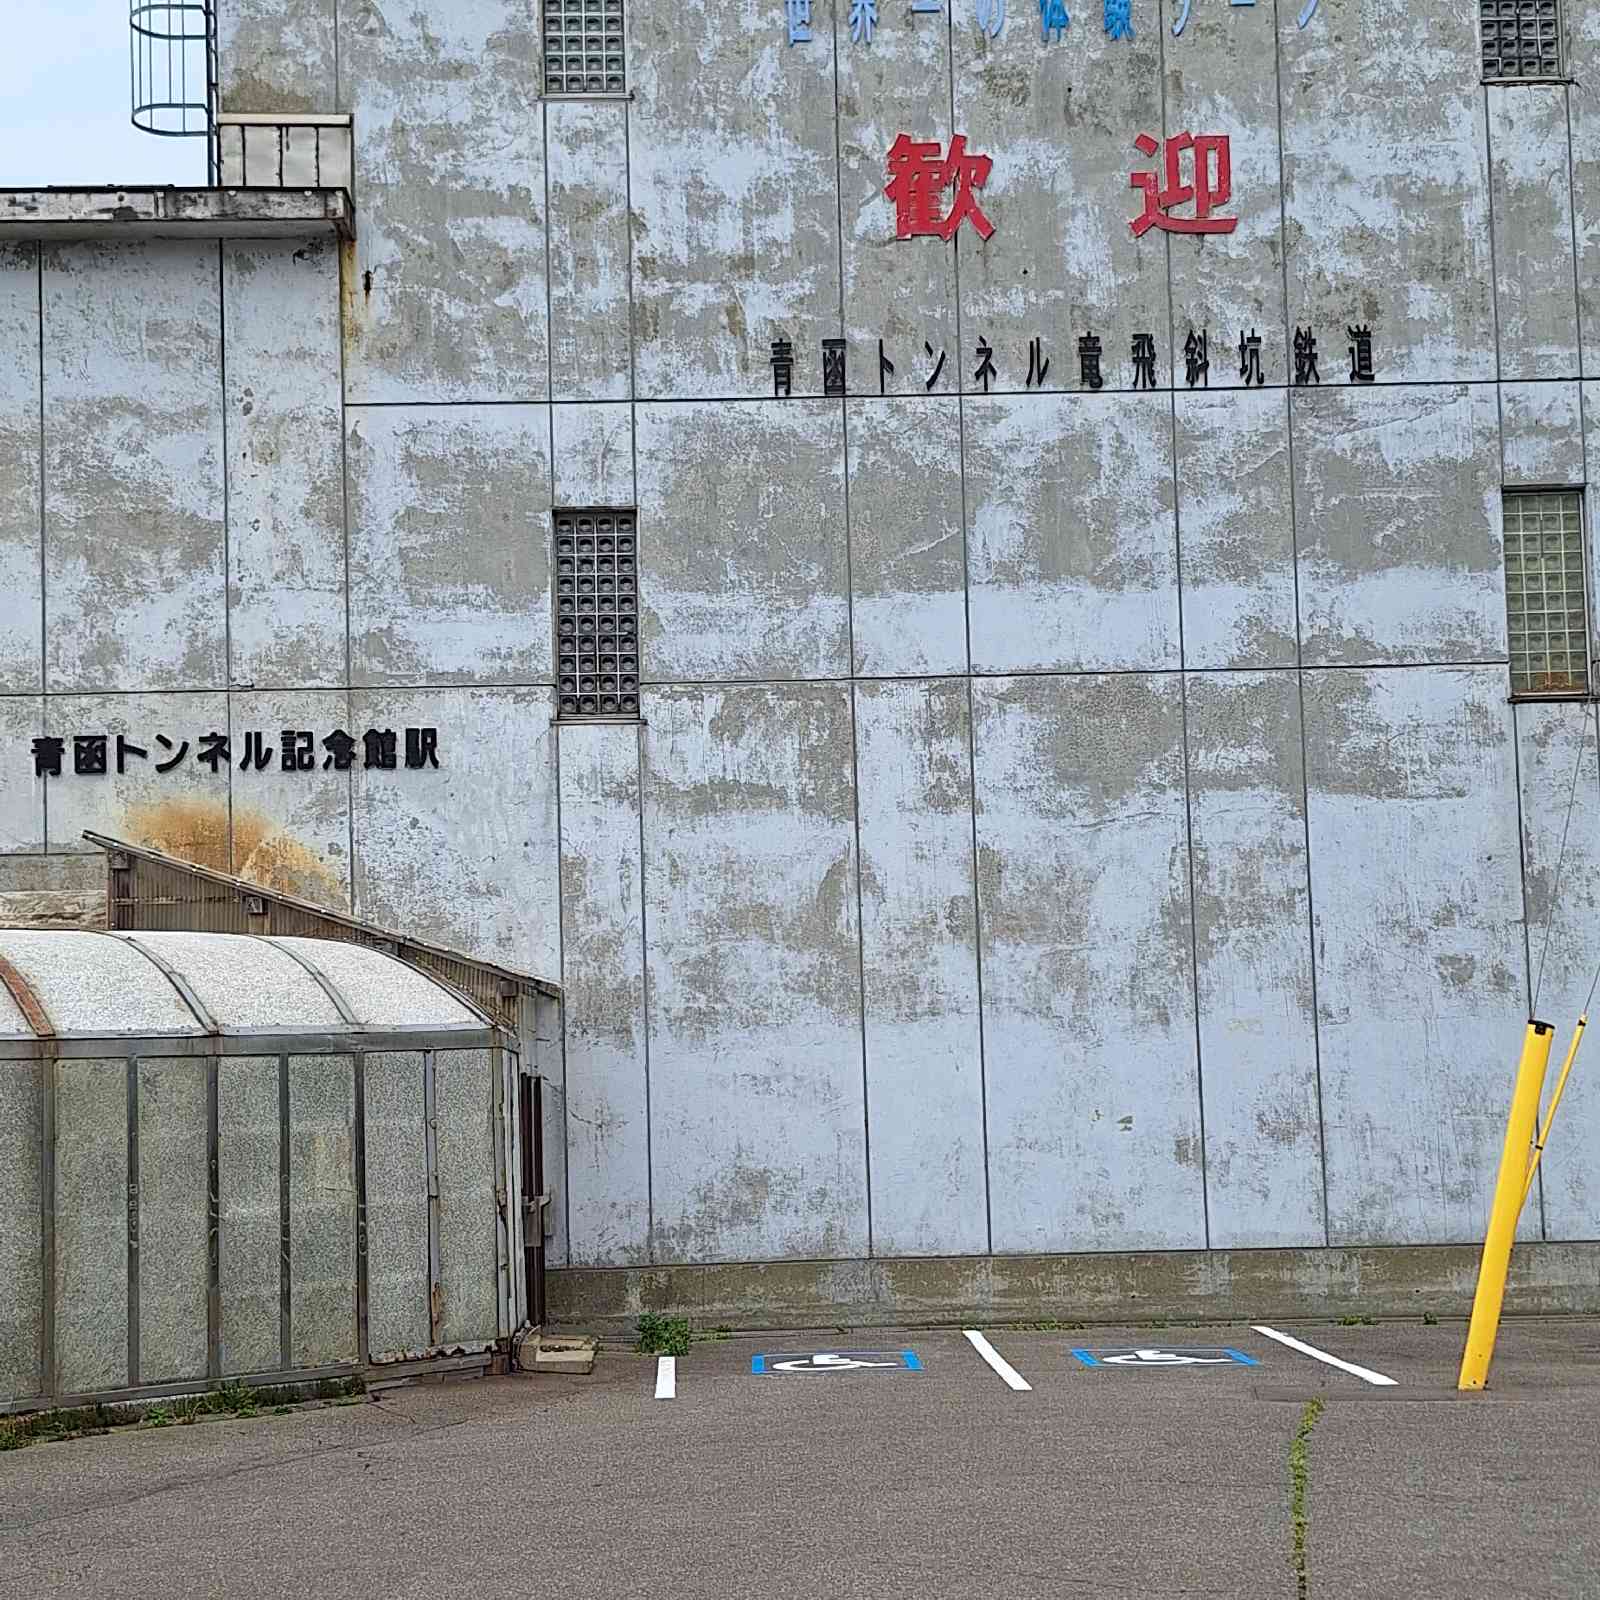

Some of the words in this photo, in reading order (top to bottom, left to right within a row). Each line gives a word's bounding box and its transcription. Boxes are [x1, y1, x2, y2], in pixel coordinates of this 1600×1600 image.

[883, 131, 1238, 242] 歓迎
[770, 324, 1376, 398] 青函トンネル竜飛斜坑鉄道
[31, 727, 440, 777] 青函トンネル記念館駅
